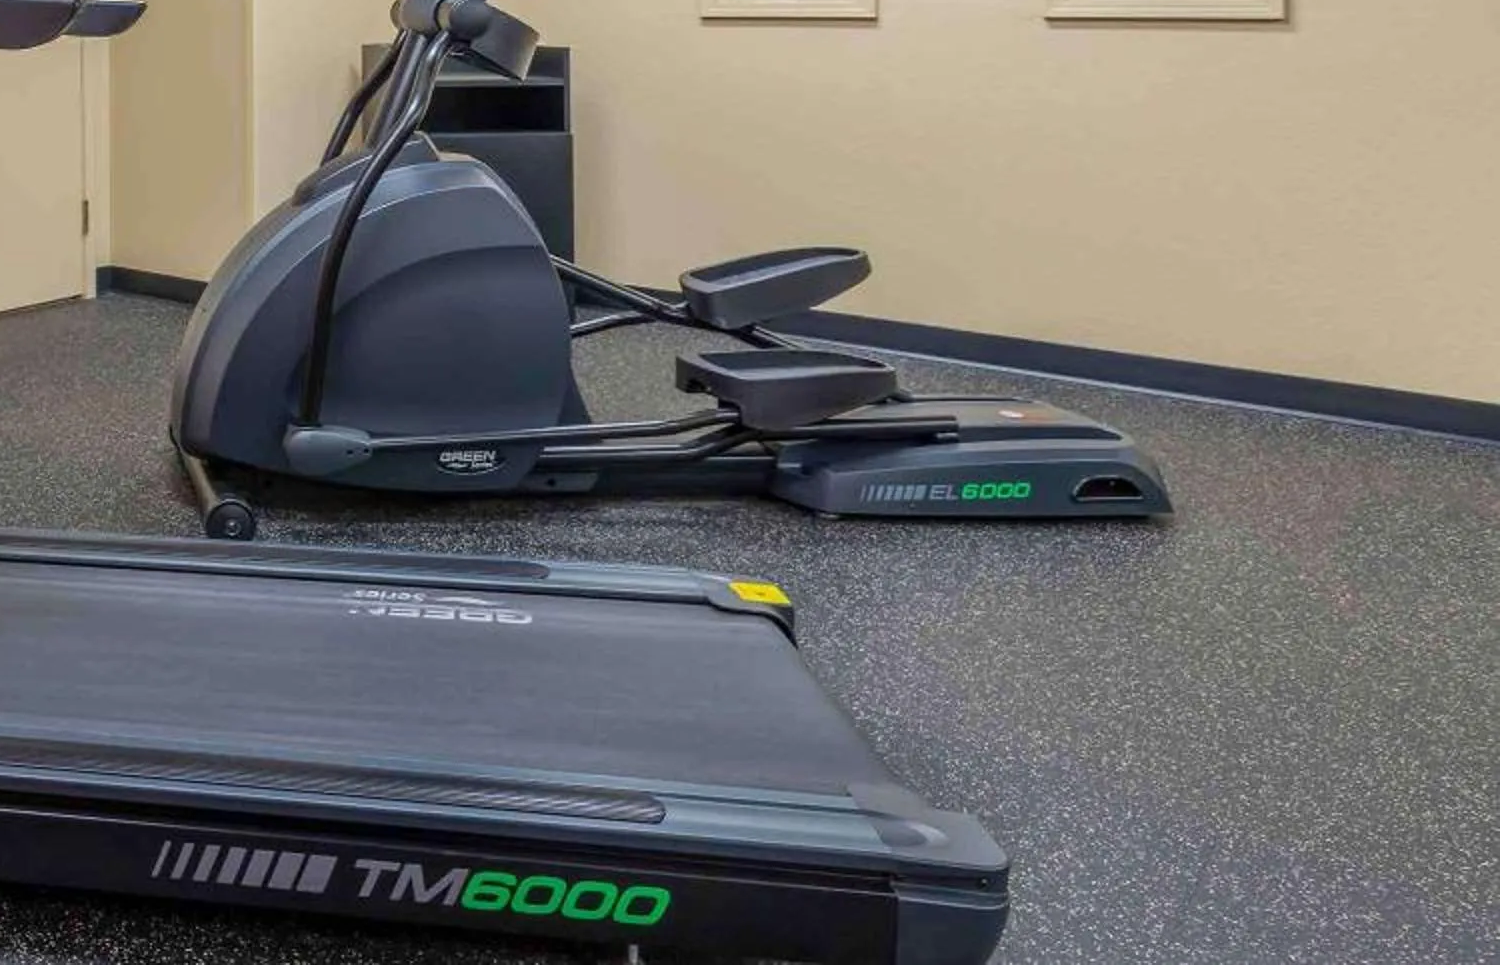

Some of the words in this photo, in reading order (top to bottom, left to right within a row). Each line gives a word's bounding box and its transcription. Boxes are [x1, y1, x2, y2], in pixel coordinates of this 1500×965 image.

[439, 450, 496, 463] GREEN
[928, 481, 1031, 502] EL6000
[353, 858, 672, 926] TM6000
